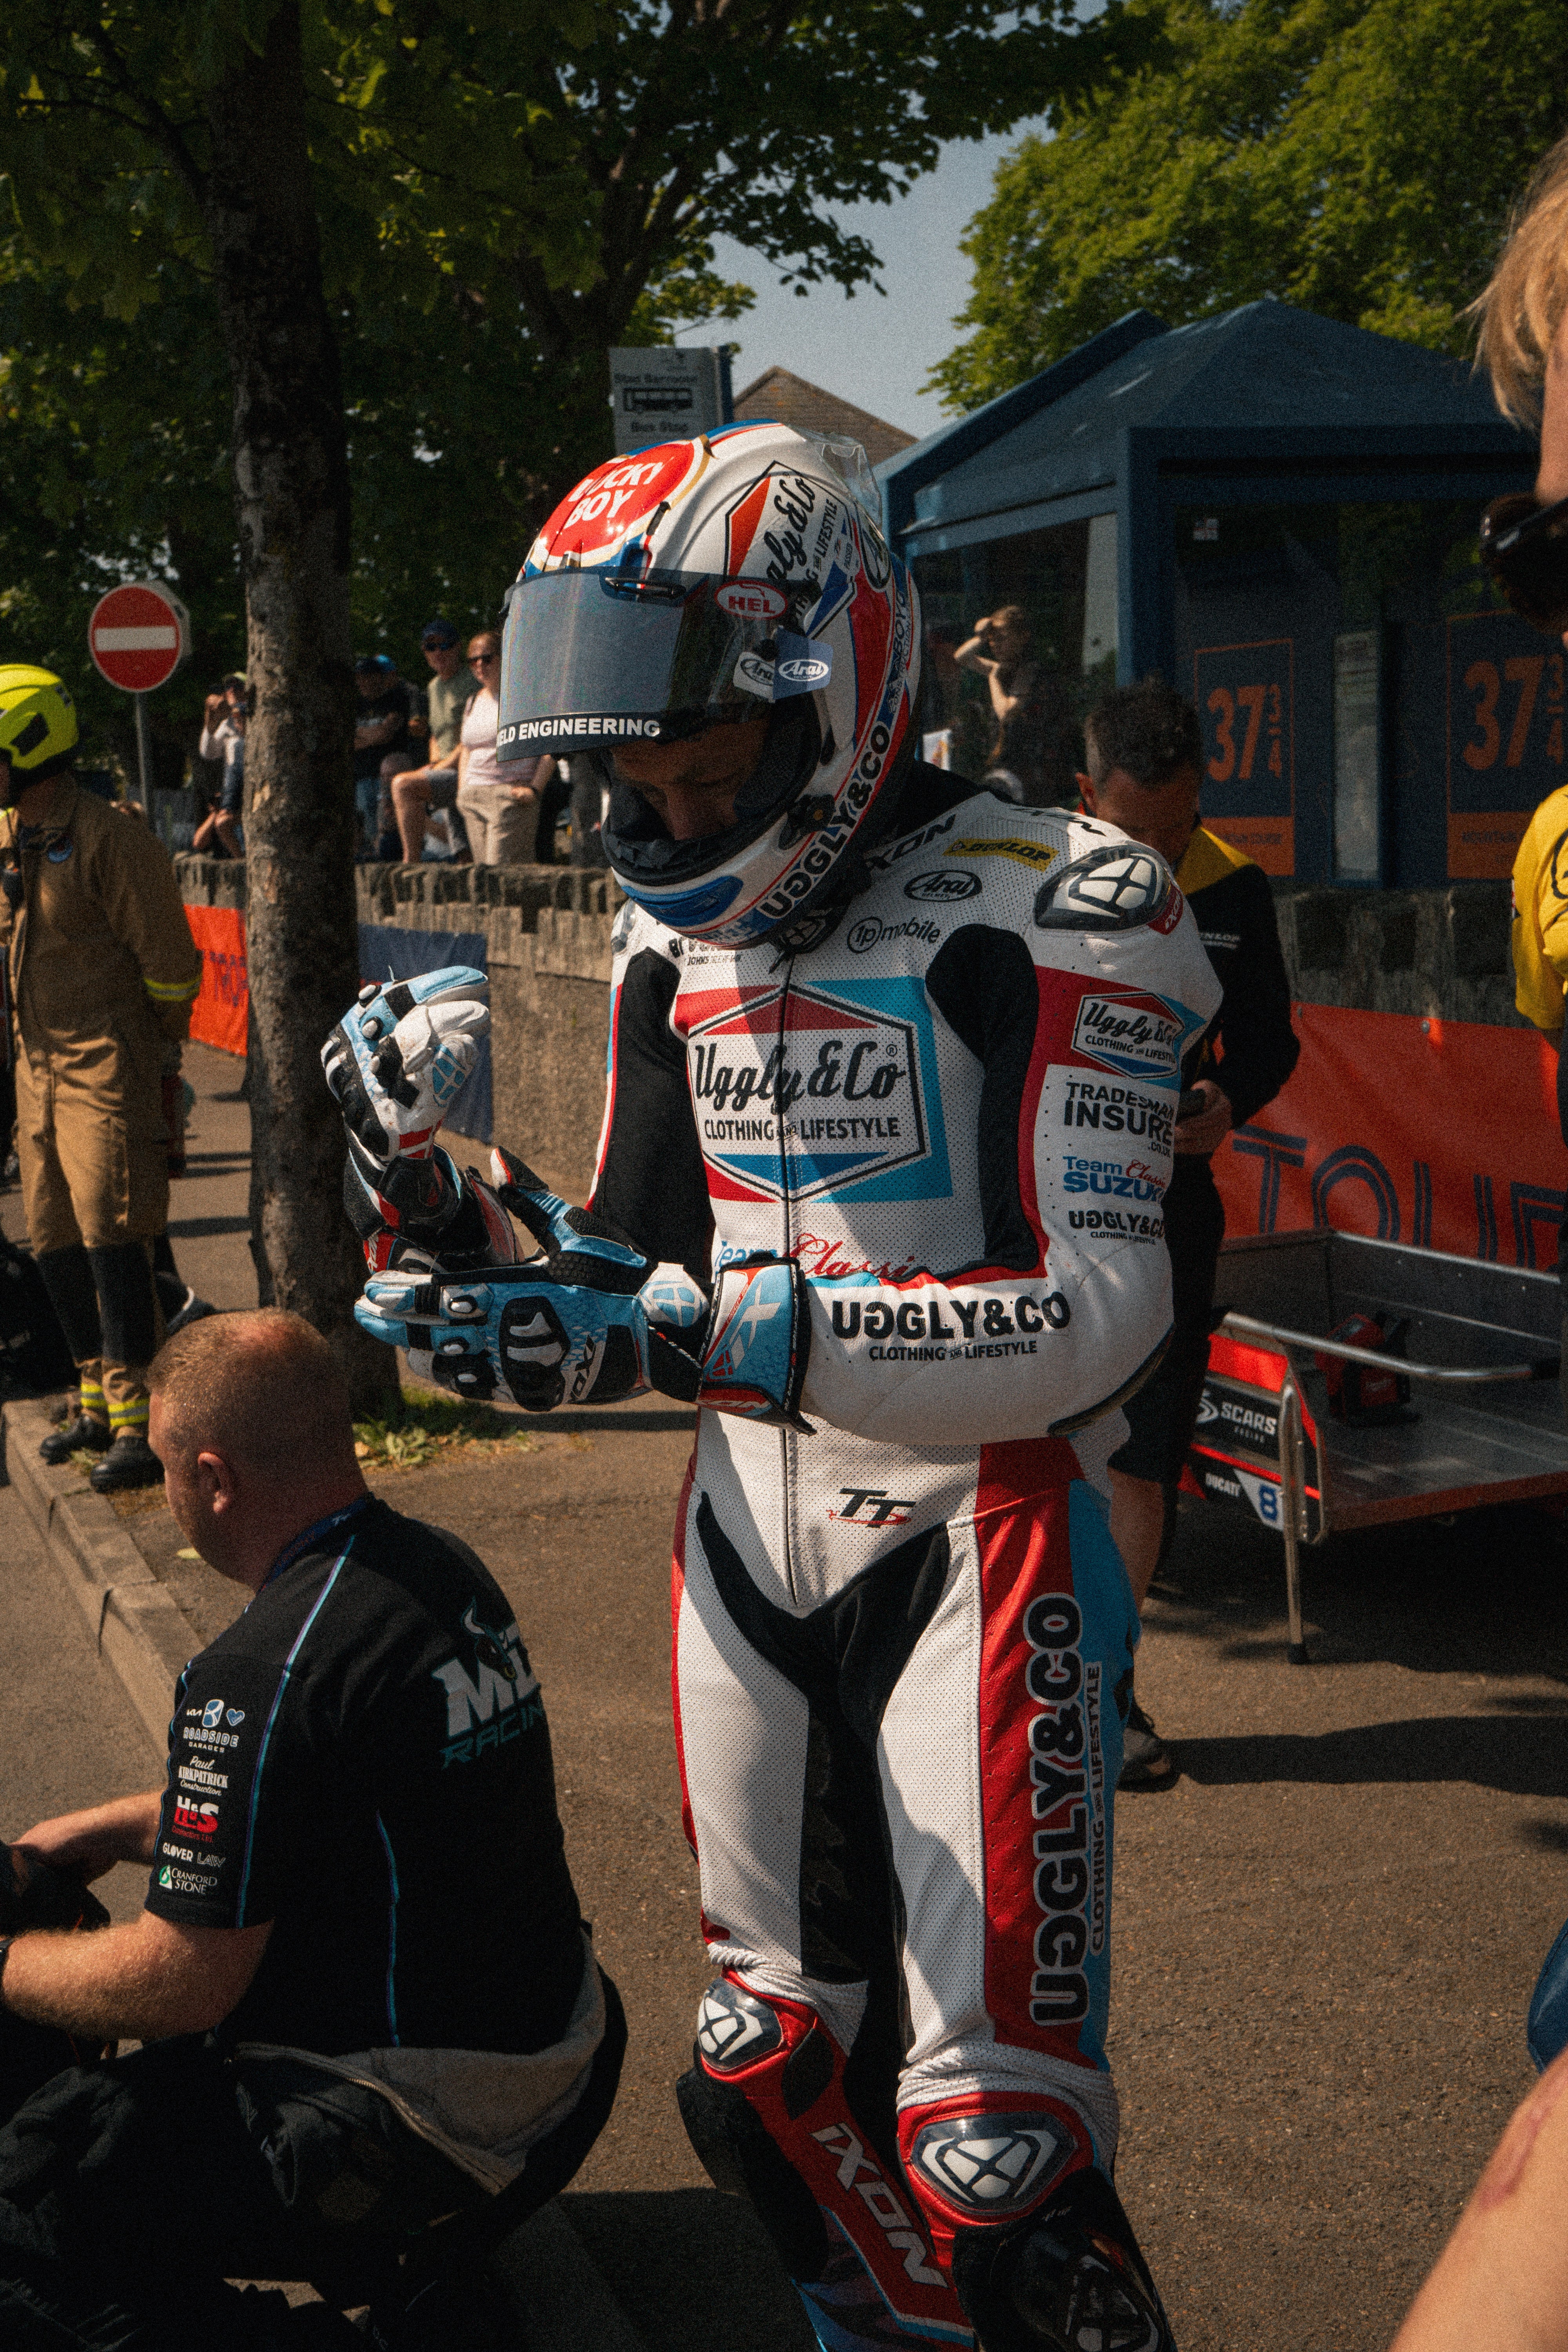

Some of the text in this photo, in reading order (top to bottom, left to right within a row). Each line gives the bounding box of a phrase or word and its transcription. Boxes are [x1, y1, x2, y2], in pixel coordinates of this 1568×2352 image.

[568, 460, 665, 502] LUCKY
[563, 489, 636, 529] BOY
[817, 498, 838, 558] LIFESTYLE
[728, 596, 776, 614] HEL
[745, 662, 774, 680] Ara
[783, 661, 822, 675] Arai
[1463, 655, 1546, 770] 37
[519, 718, 660, 740] ENGINEERING
[1207, 684, 1267, 781] 37
[966, 841, 1050, 861] DUNLOP
[911, 873, 974, 893] Arai
[1085, 1035, 1133, 1053] CLOTHING
[706, 1118, 774, 1140] CLOTHING
[800, 1117, 901, 1140] LIFESTYLE
[1063, 1156, 1122, 1175] Team
[869, 1346, 946, 1362] CLOTHING
[965, 1340, 1037, 1359] LIFESTYLE
[1220, 1401, 1278, 1436] SCARS
[839, 1488, 917, 1528] TT
[1259, 1484, 1278, 1522] 8
[183, 1726, 240, 1748] ROADSIDE
[439, 1704, 543, 1771] RACIN
[1087, 1666, 1103, 1788] LIFESTYLE
[188, 1741, 225, 1753] GARAGES
[189, 1755, 215, 1771] Paul
[178, 1765, 229, 1789] KIRKPATRICK
[180, 1779, 223, 1796] Construction
[162, 1842, 226, 1868] GLOVER LAW
[171, 1867, 218, 1887] CRANFORD
[174, 1878, 208, 1895] STONE
[1092, 1820, 1104, 1951] CLOTHING
[810, 2121, 950, 2290] IXON
